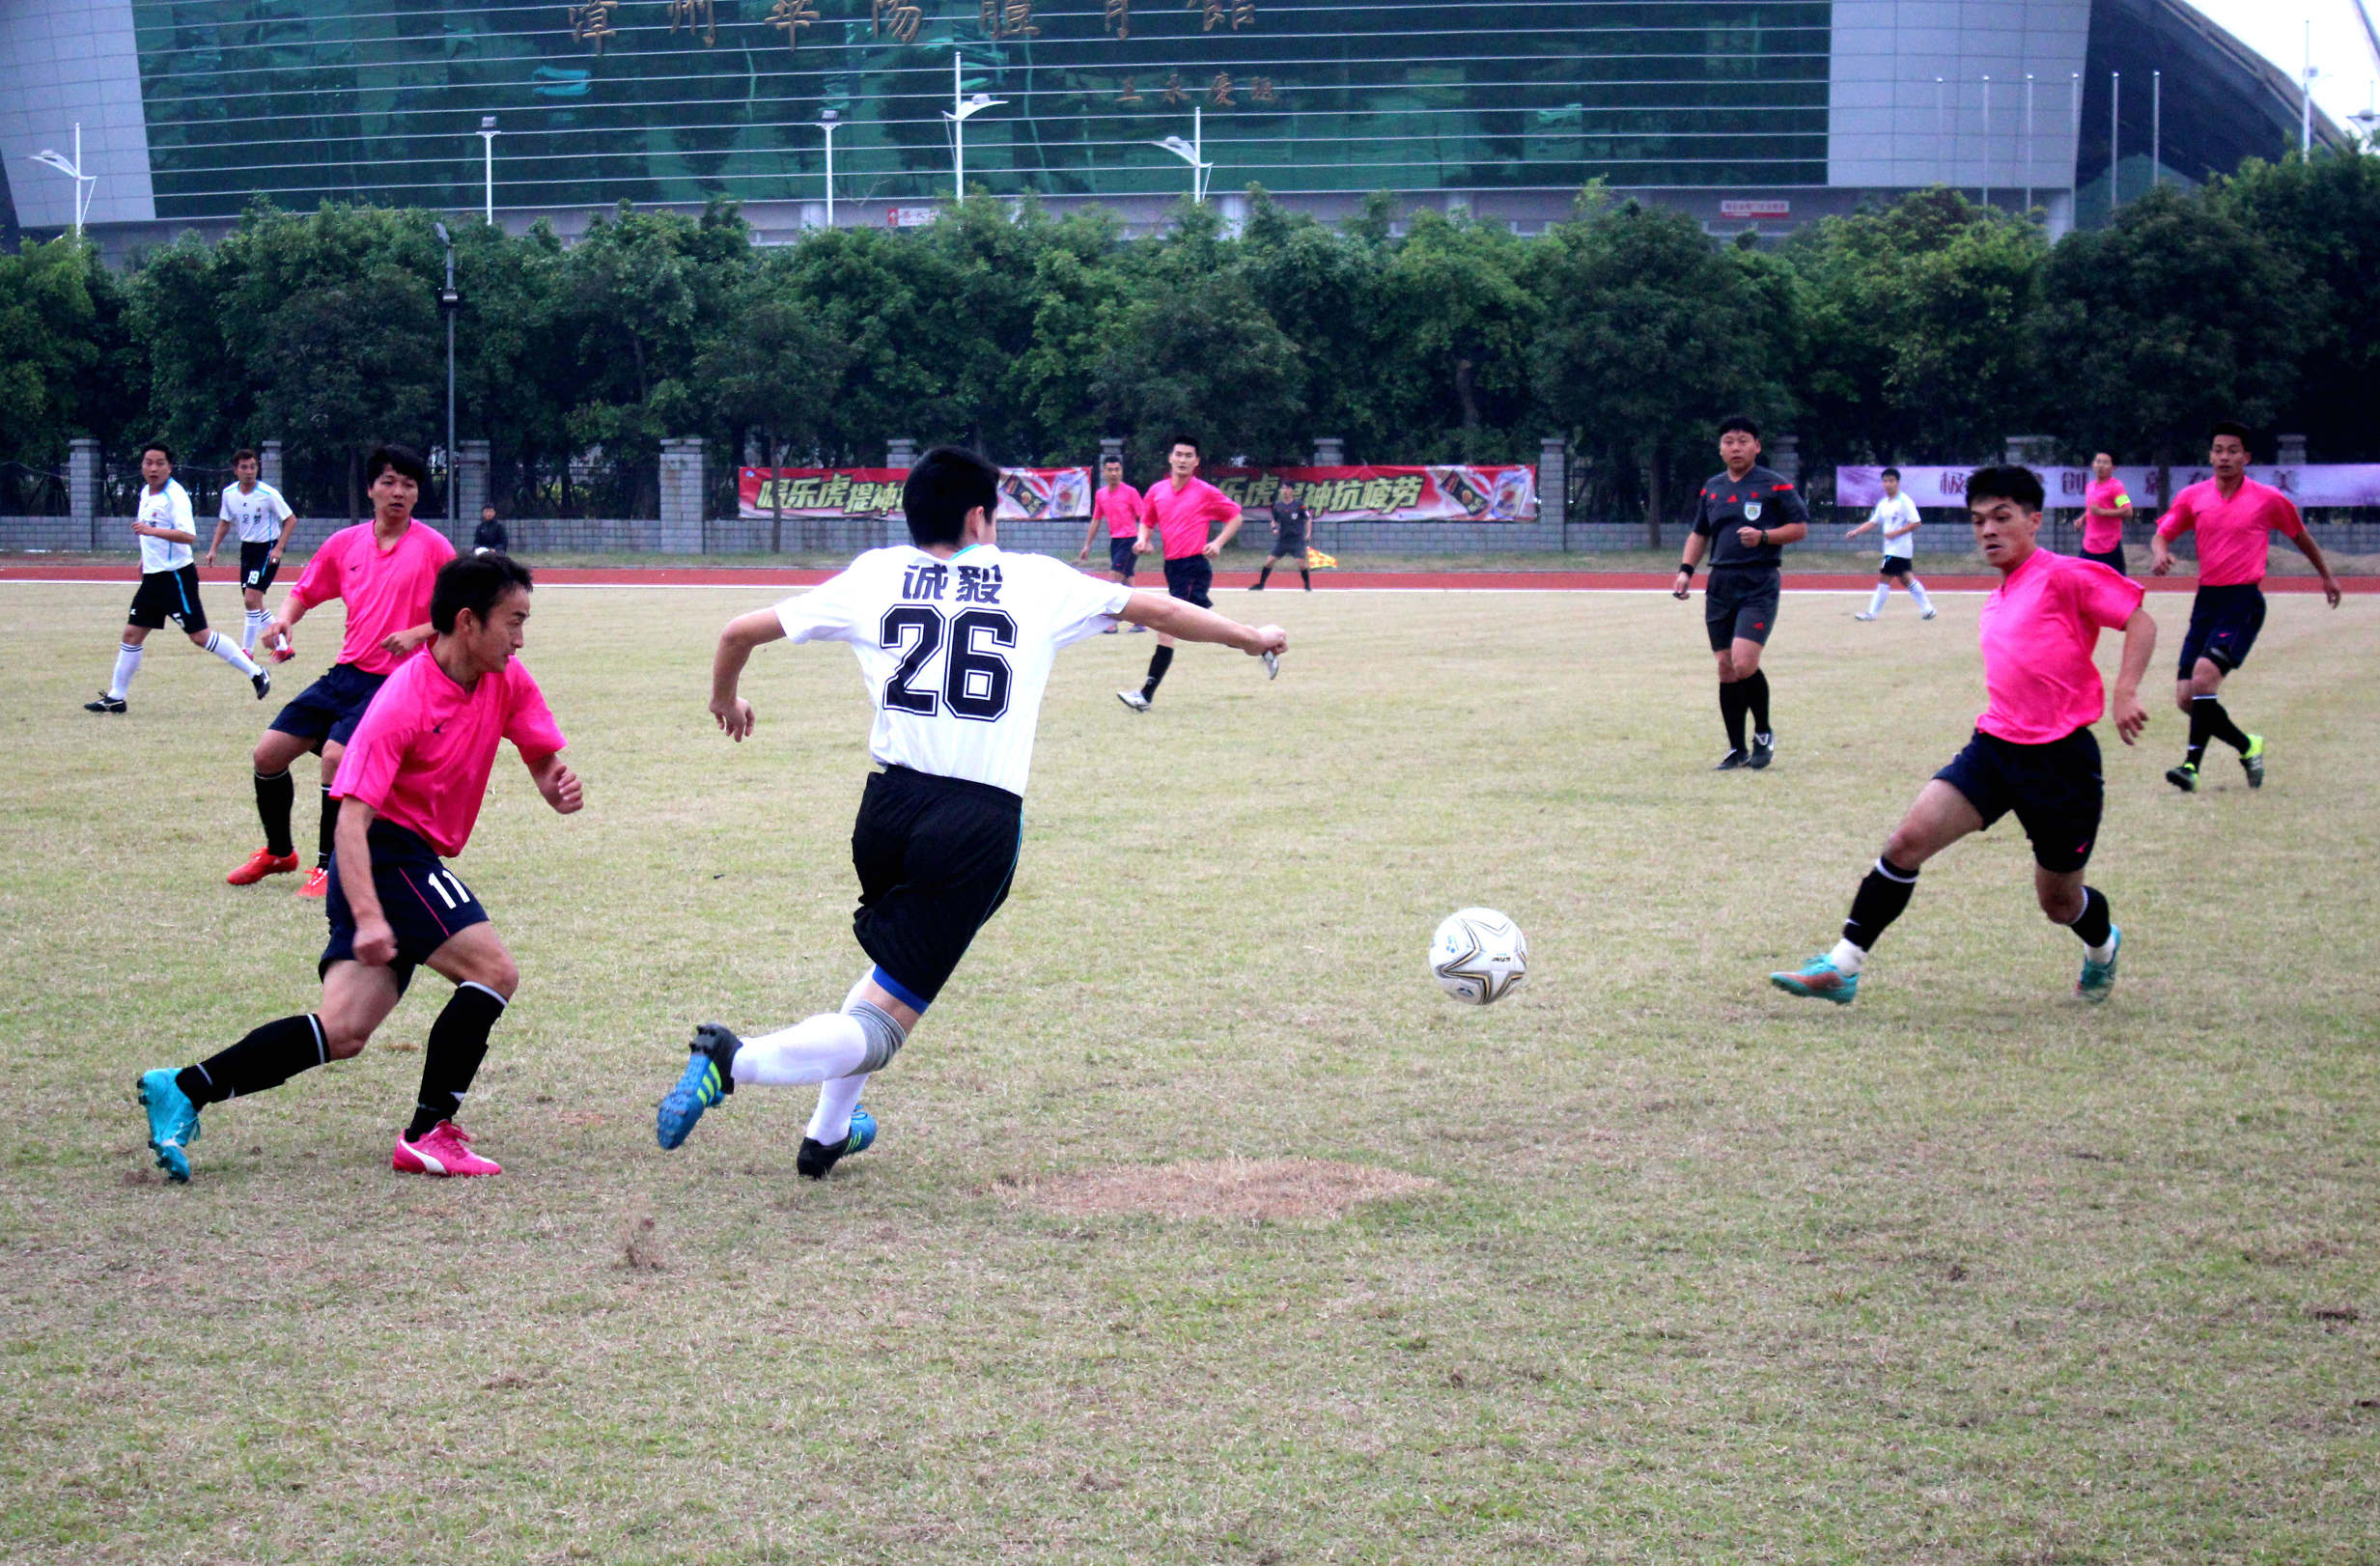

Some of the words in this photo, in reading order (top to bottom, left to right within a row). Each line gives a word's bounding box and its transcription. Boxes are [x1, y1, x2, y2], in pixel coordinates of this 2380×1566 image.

[755, 471, 906, 517] 喝乐虎提神
[1214, 472, 1424, 517] 乐虎神抗疲劳
[902, 564, 1003, 604] 诚毅
[880, 603, 1018, 722] 26
[428, 870, 471, 909] 11
